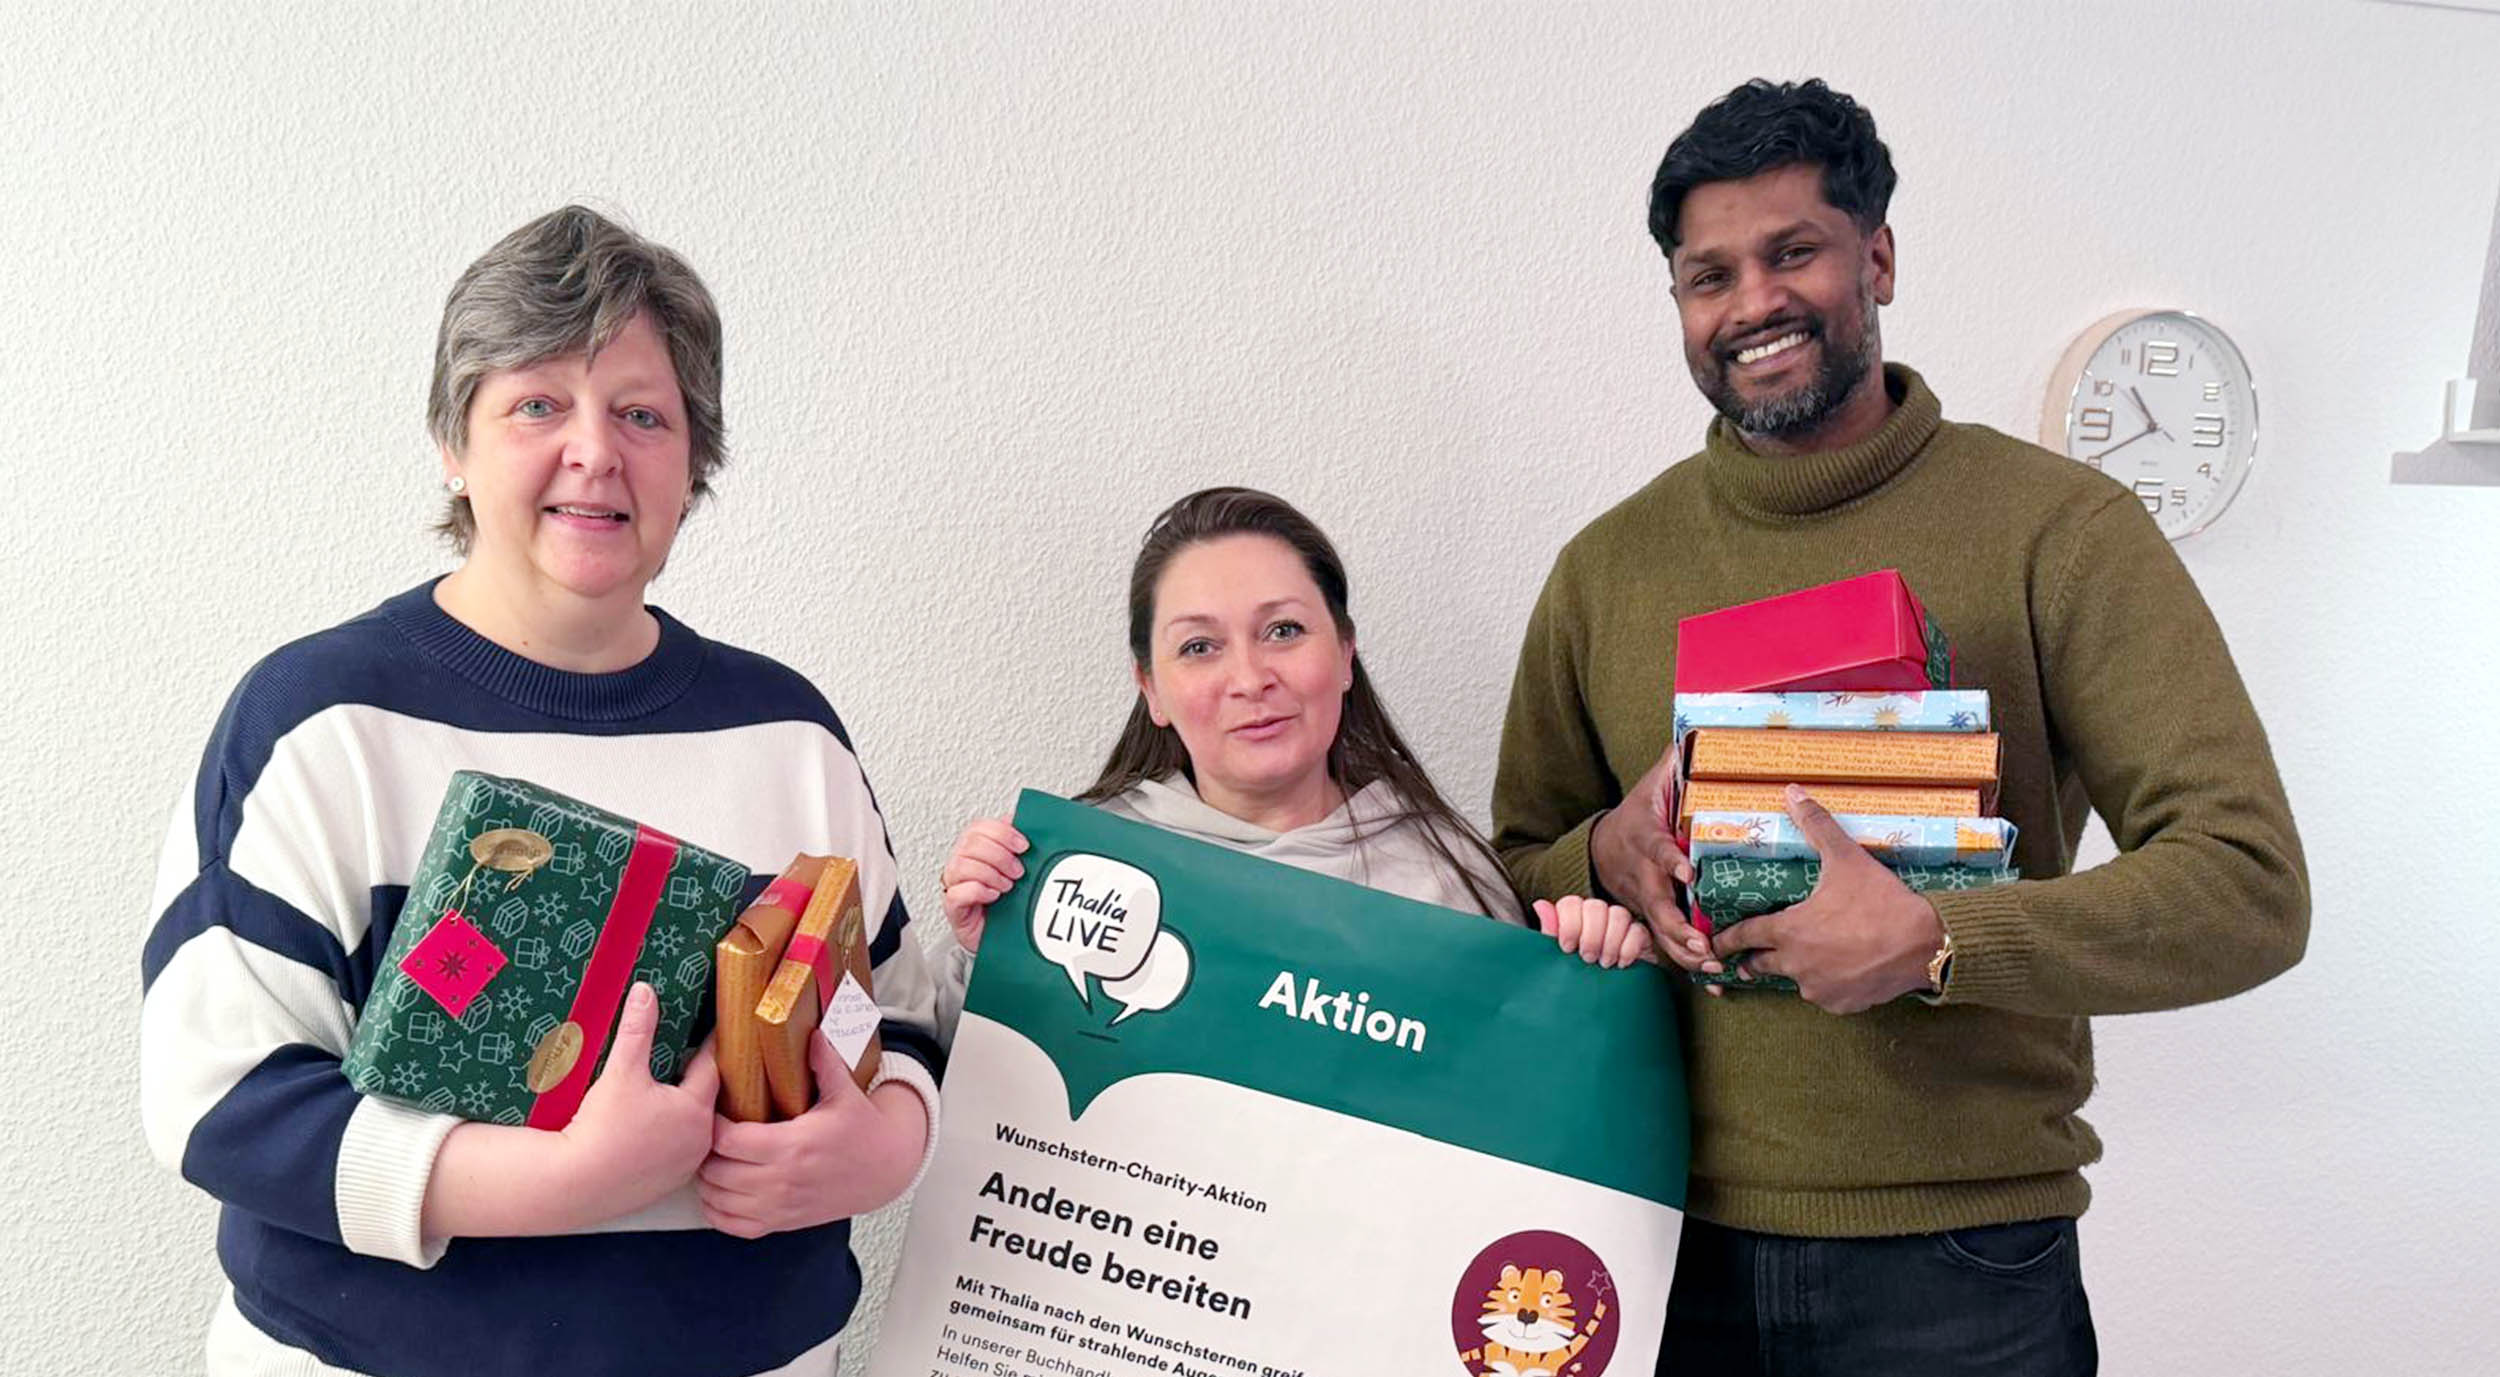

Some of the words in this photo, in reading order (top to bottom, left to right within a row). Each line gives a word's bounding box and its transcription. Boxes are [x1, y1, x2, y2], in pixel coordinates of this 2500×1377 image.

[2139, 340, 2179, 377] 12
[2203, 382, 2221, 402] 2
[2079, 407, 2113, 442] 9
[2192, 412, 2225, 448] 3
[2196, 462, 2211, 478] 4
[2171, 486, 2188, 506] 5
[1053, 878, 1128, 923] Thalia
[1046, 909, 1125, 953] LIVE
[1258, 970, 1428, 1052] Aktion
[995, 1122, 1268, 1213] Wunschstern-Charity-Aktion
[979, 1171, 1133, 1237] Anderen
[1144, 1220, 1219, 1260] eine
[969, 1215, 1092, 1274] Freude
[1101, 1251, 1252, 1320] bereiten
[942, 1323, 957, 1341] In
[961, 1331, 1023, 1360] unserer
[950, 1299, 1046, 1337] gemeinsam
[1050, 1325, 1076, 1345] für
[1078, 1336, 1169, 1371] strahlende
[955, 1275, 984, 1296] Mit
[989, 1285, 1040, 1312] Thalia
[1043, 1304, 1085, 1325] nach
[1089, 1315, 1122, 1335] den
[1126, 1323, 1258, 1374] Wunschsternen
[936, 1345, 989, 1373] Helfen
